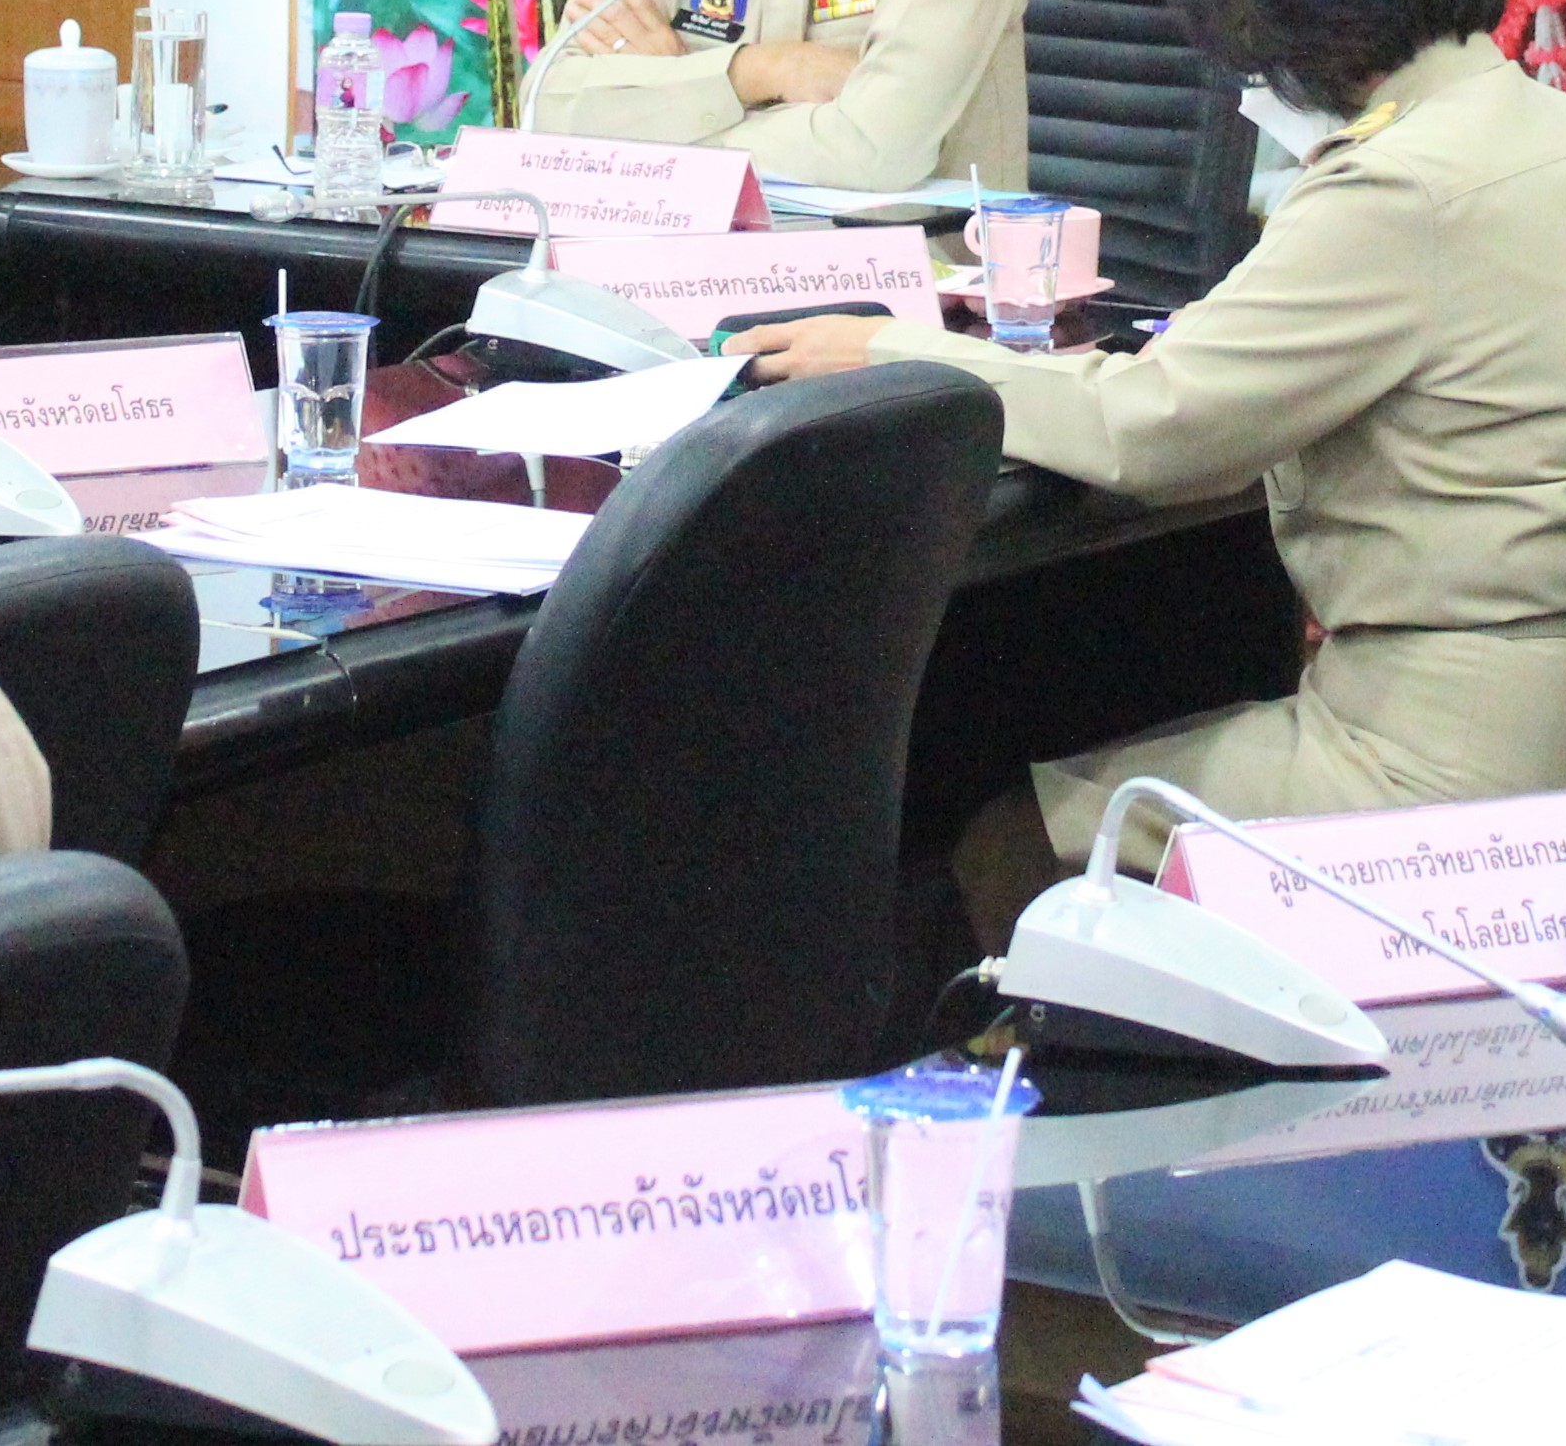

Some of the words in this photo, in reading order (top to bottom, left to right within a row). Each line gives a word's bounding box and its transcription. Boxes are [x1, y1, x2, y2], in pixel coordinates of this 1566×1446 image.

[520, 149, 616, 176] นายชัยวัฒน์
[619, 157, 677, 181] แสงศรี
[603, 257, 923, 300] ษตรและสหกรณ์จังหวัดยโสธร
